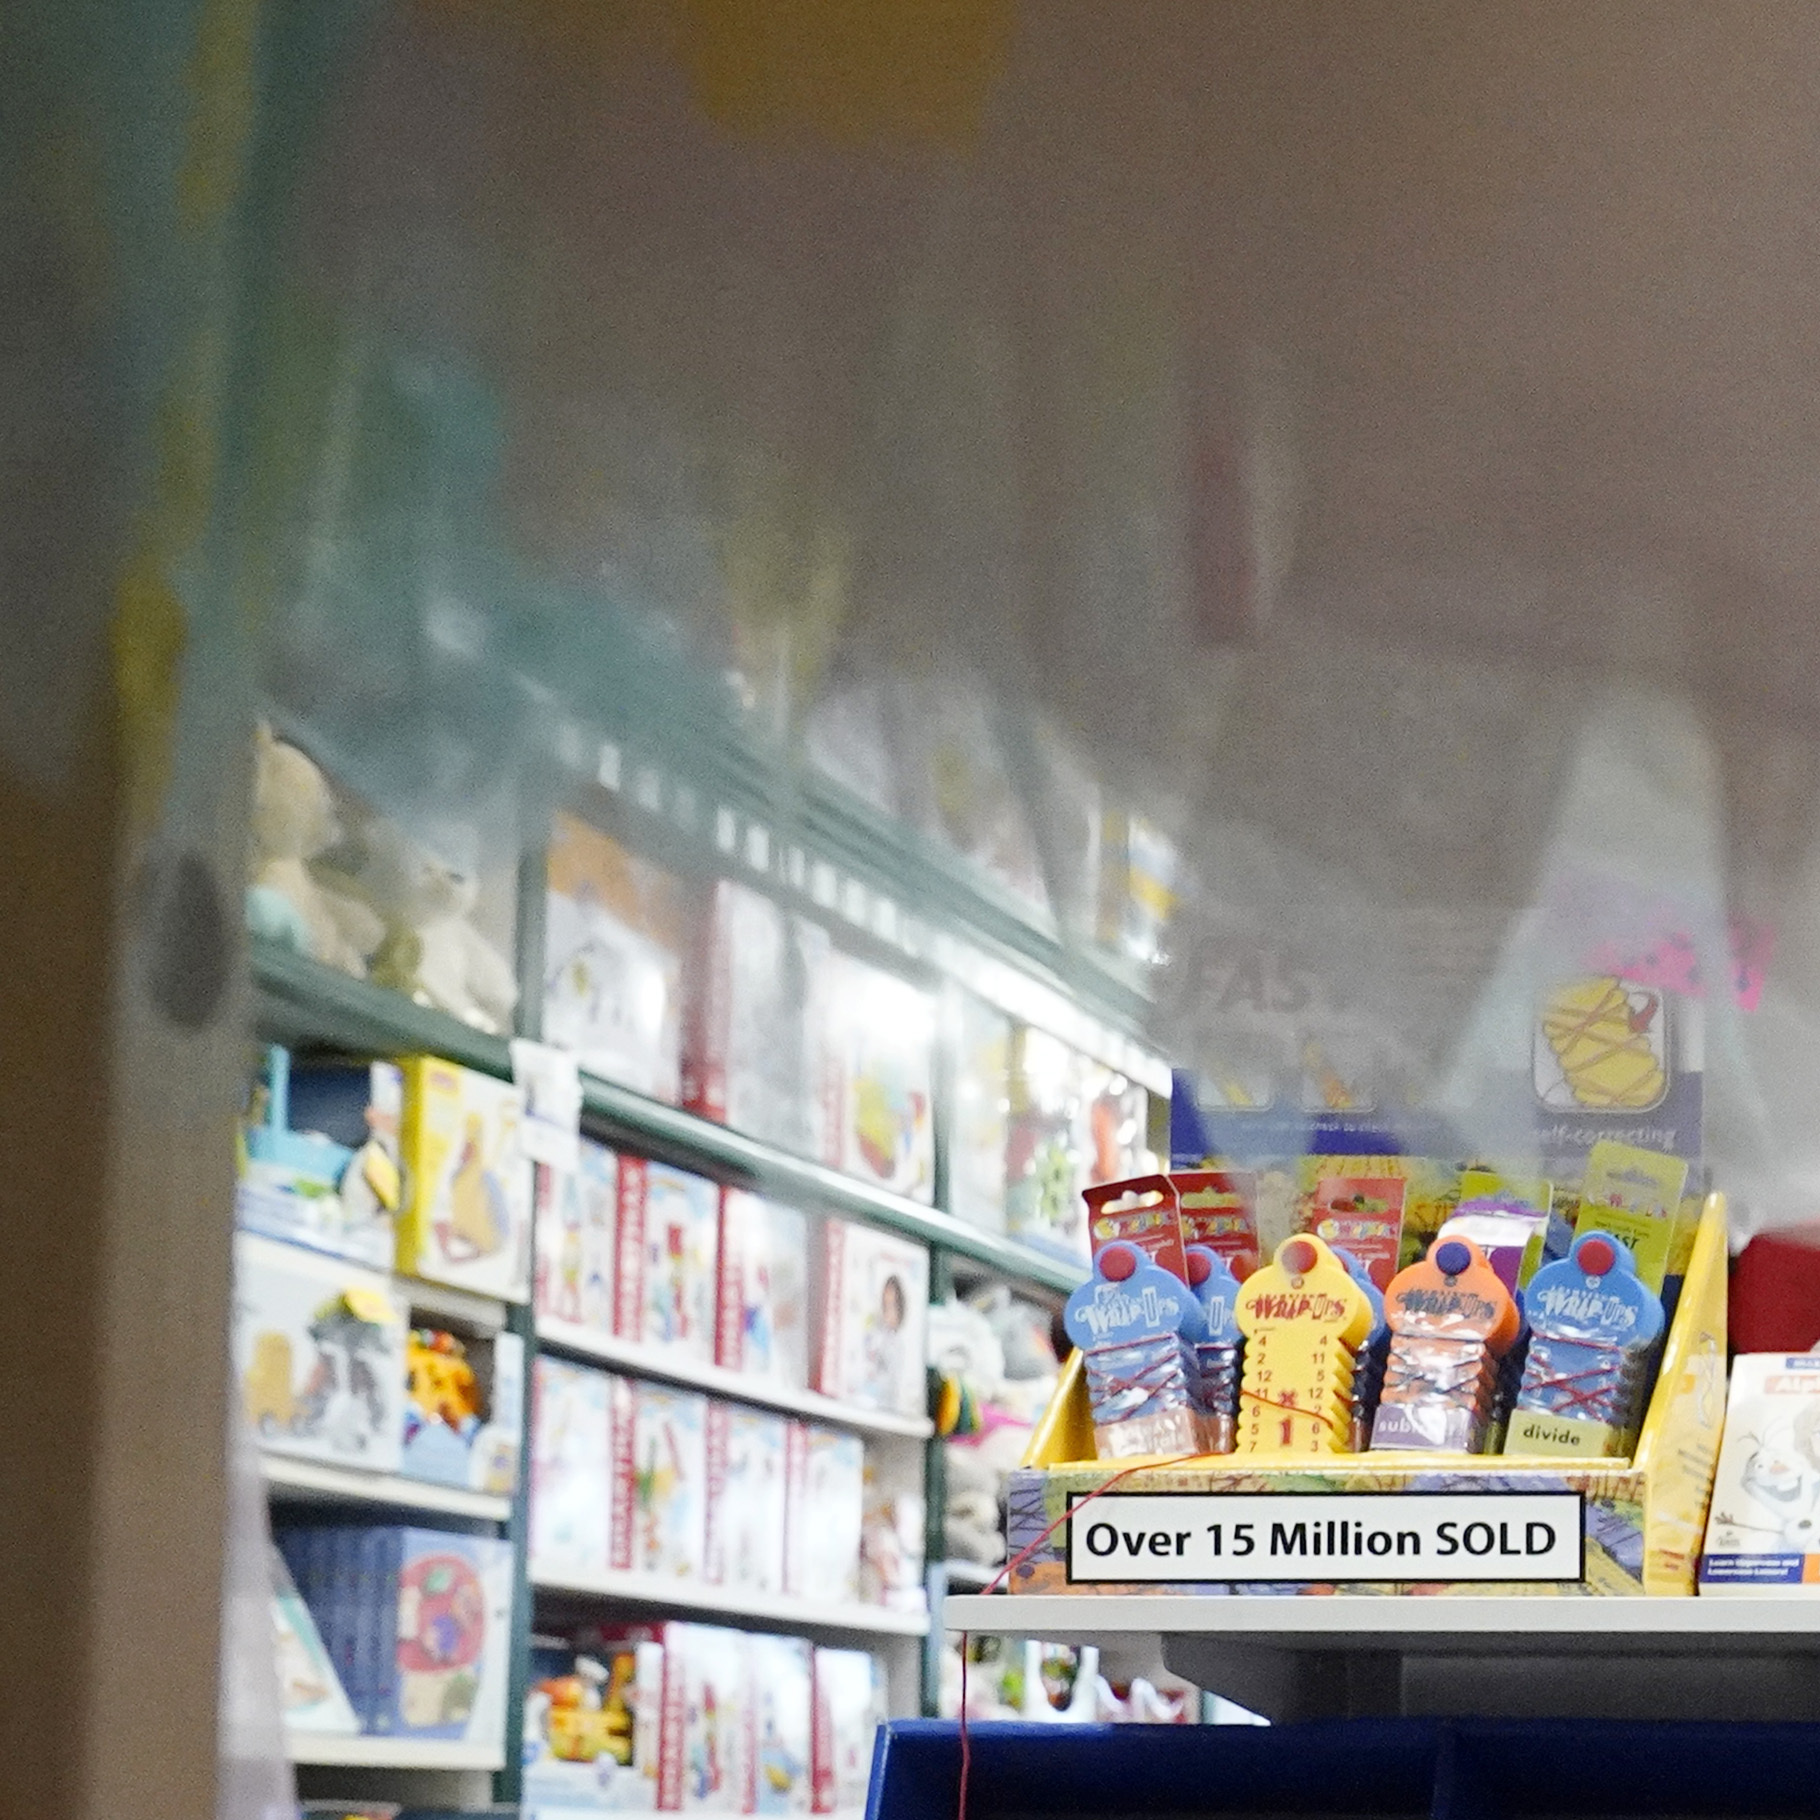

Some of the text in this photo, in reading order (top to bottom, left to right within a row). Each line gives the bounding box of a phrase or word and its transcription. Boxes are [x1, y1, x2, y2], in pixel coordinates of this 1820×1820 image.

[1523, 1423, 1582, 1446] divide
[1085, 1520, 1556, 1557] Over 15 Million SOLD
